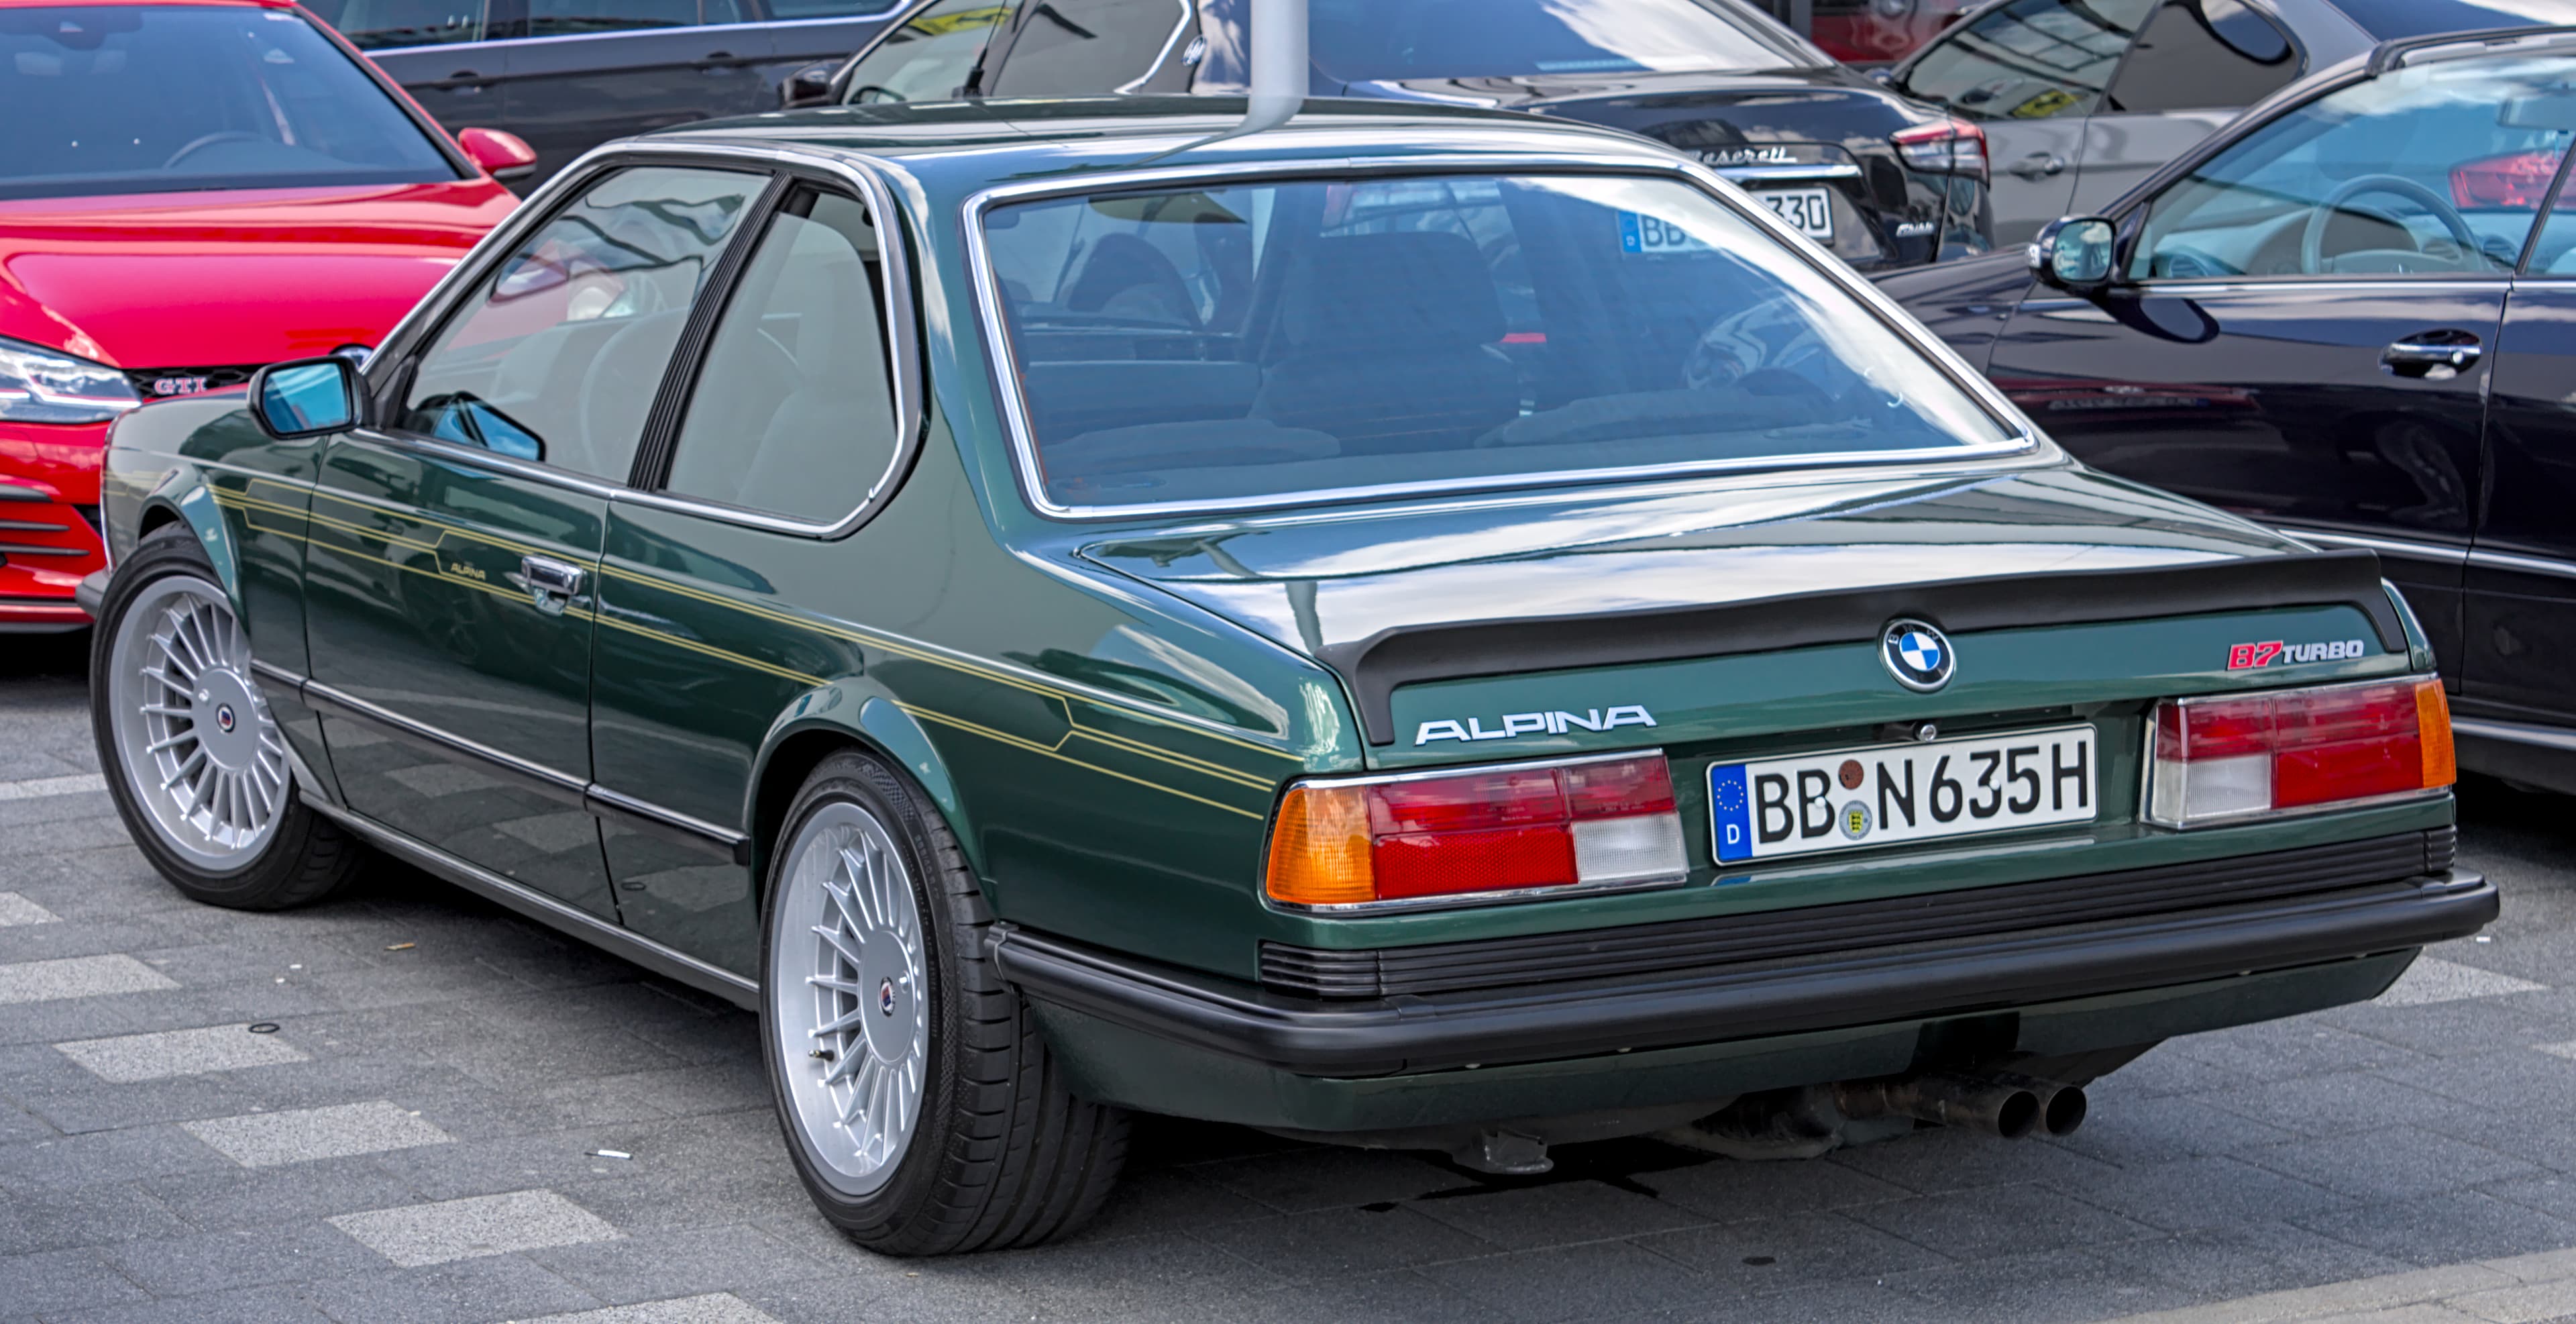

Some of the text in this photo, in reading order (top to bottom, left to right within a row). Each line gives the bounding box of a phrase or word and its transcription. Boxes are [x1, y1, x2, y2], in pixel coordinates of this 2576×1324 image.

[154, 376, 207, 395] GTI
[451, 562, 486, 580] ALPINA
[2226, 640, 2364, 670] B7 TURBO
[1414, 705, 1658, 747] ALPINA
[1726, 823, 1741, 845] D
[1754, 768, 1835, 844] BB
